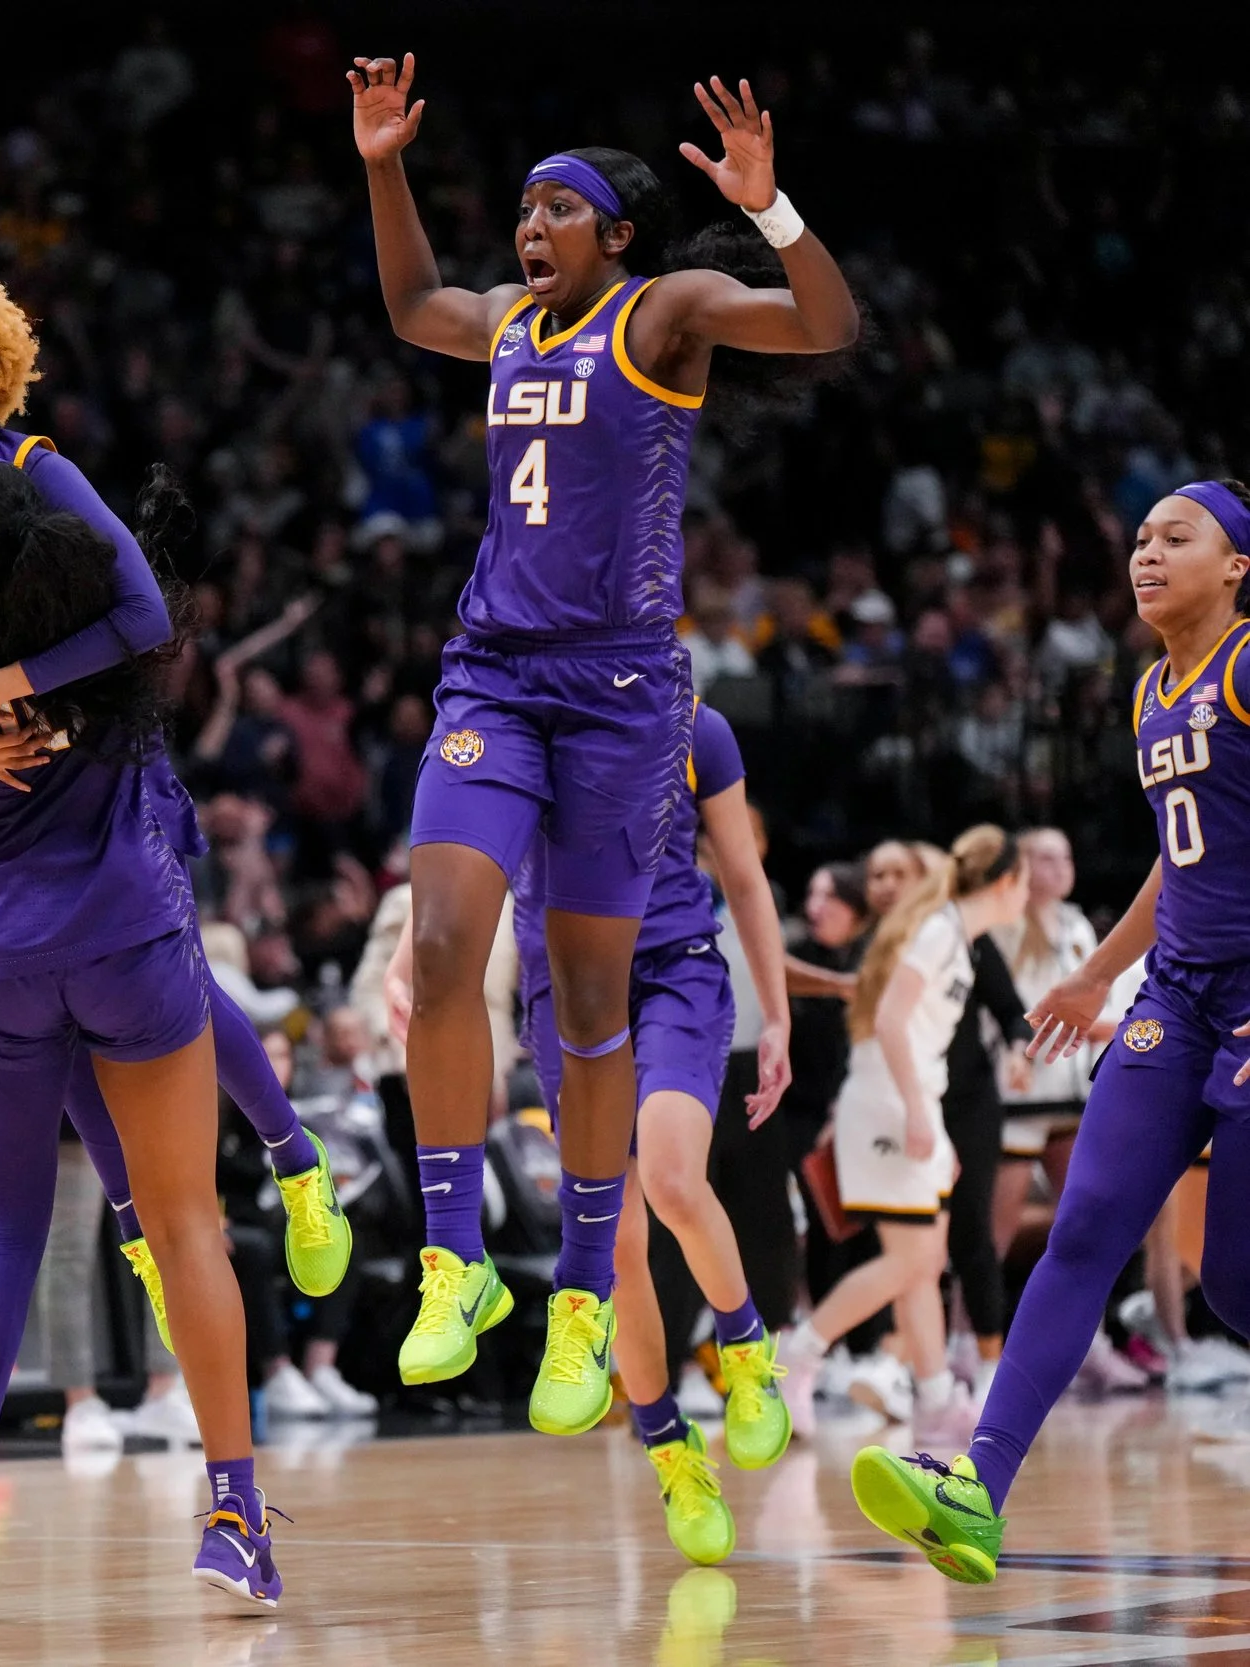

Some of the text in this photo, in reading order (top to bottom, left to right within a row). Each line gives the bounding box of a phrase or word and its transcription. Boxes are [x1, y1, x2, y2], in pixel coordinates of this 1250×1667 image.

[575, 358, 594, 376] SEC
[487, 380, 588, 426] LSU
[510, 438, 550, 525] 4
[1192, 704, 1213, 723] SEC
[1137, 730, 1211, 789] LSU
[1165, 786, 1206, 868] 0
